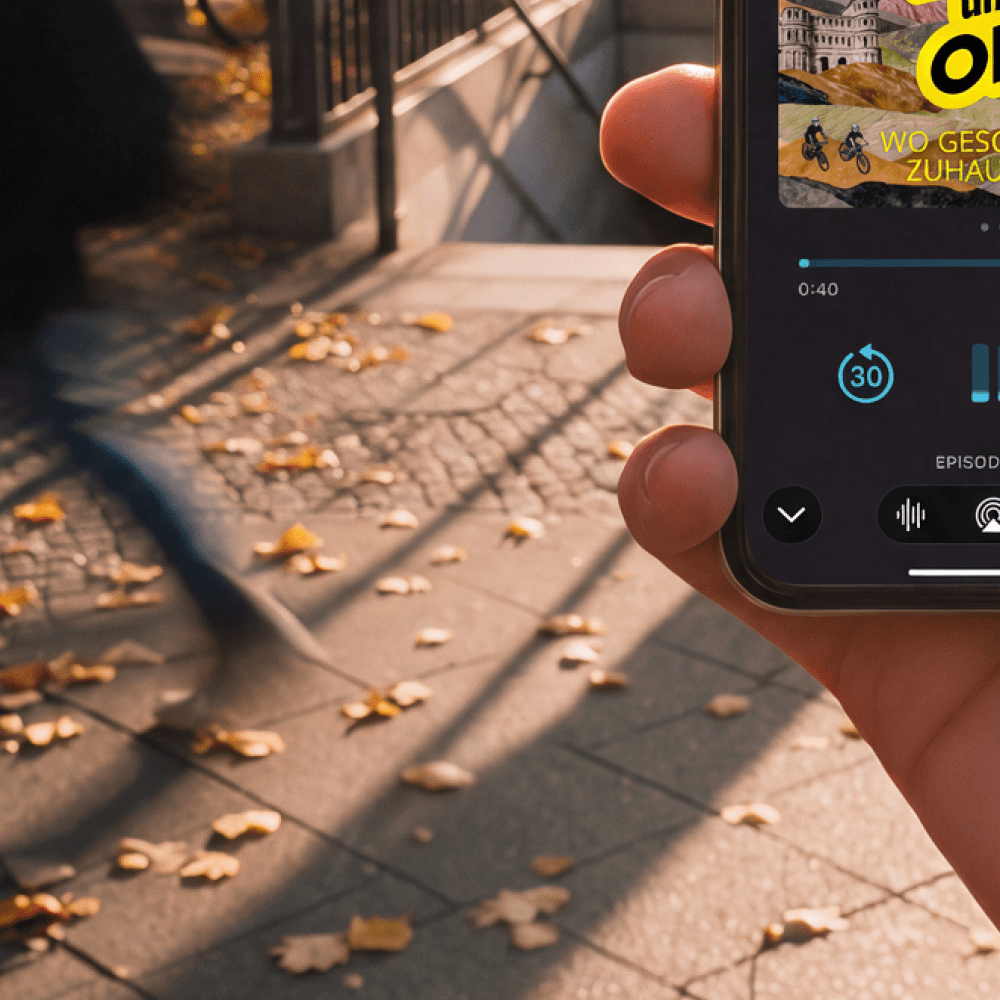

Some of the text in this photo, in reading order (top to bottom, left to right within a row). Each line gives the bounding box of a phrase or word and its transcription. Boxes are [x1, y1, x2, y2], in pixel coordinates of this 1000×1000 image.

[880, 129, 929, 154] WO
[798, 281, 839, 297] 0:40
[850, 366, 883, 388] 30
